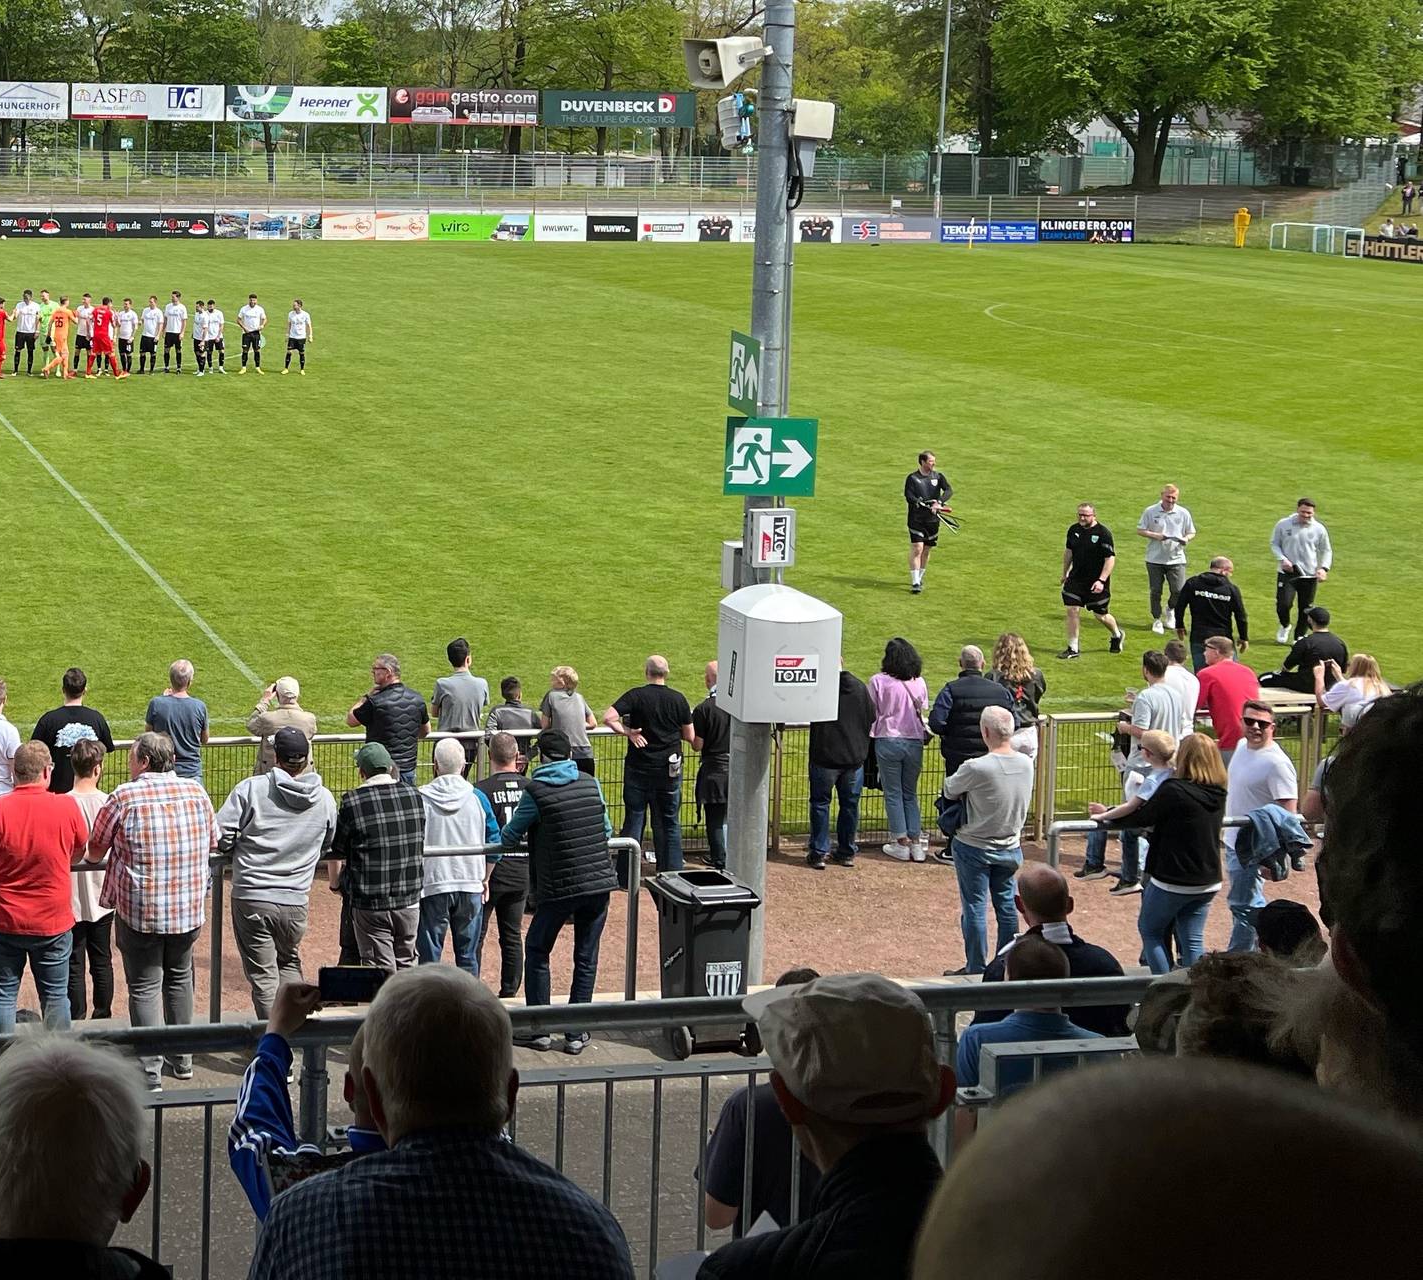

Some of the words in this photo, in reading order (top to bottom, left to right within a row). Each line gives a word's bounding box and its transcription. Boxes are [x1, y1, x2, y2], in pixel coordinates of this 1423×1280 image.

[91, 88, 130, 104] ASF
[560, 99, 656, 113] DUVENBECK
[308, 108, 348, 118] Hamacher
[561, 114, 578, 123] THE
[579, 115, 618, 123] CULTURE
[619, 115, 630, 123] OF
[632, 115, 676, 124] LOGISTICS
[942, 225, 988, 235] TEKLOTH
[1041, 220, 1133, 231] KLINGEBERG.COM
[776, 658, 798, 666] SPORT
[776, 670, 817, 682] TOTAL
